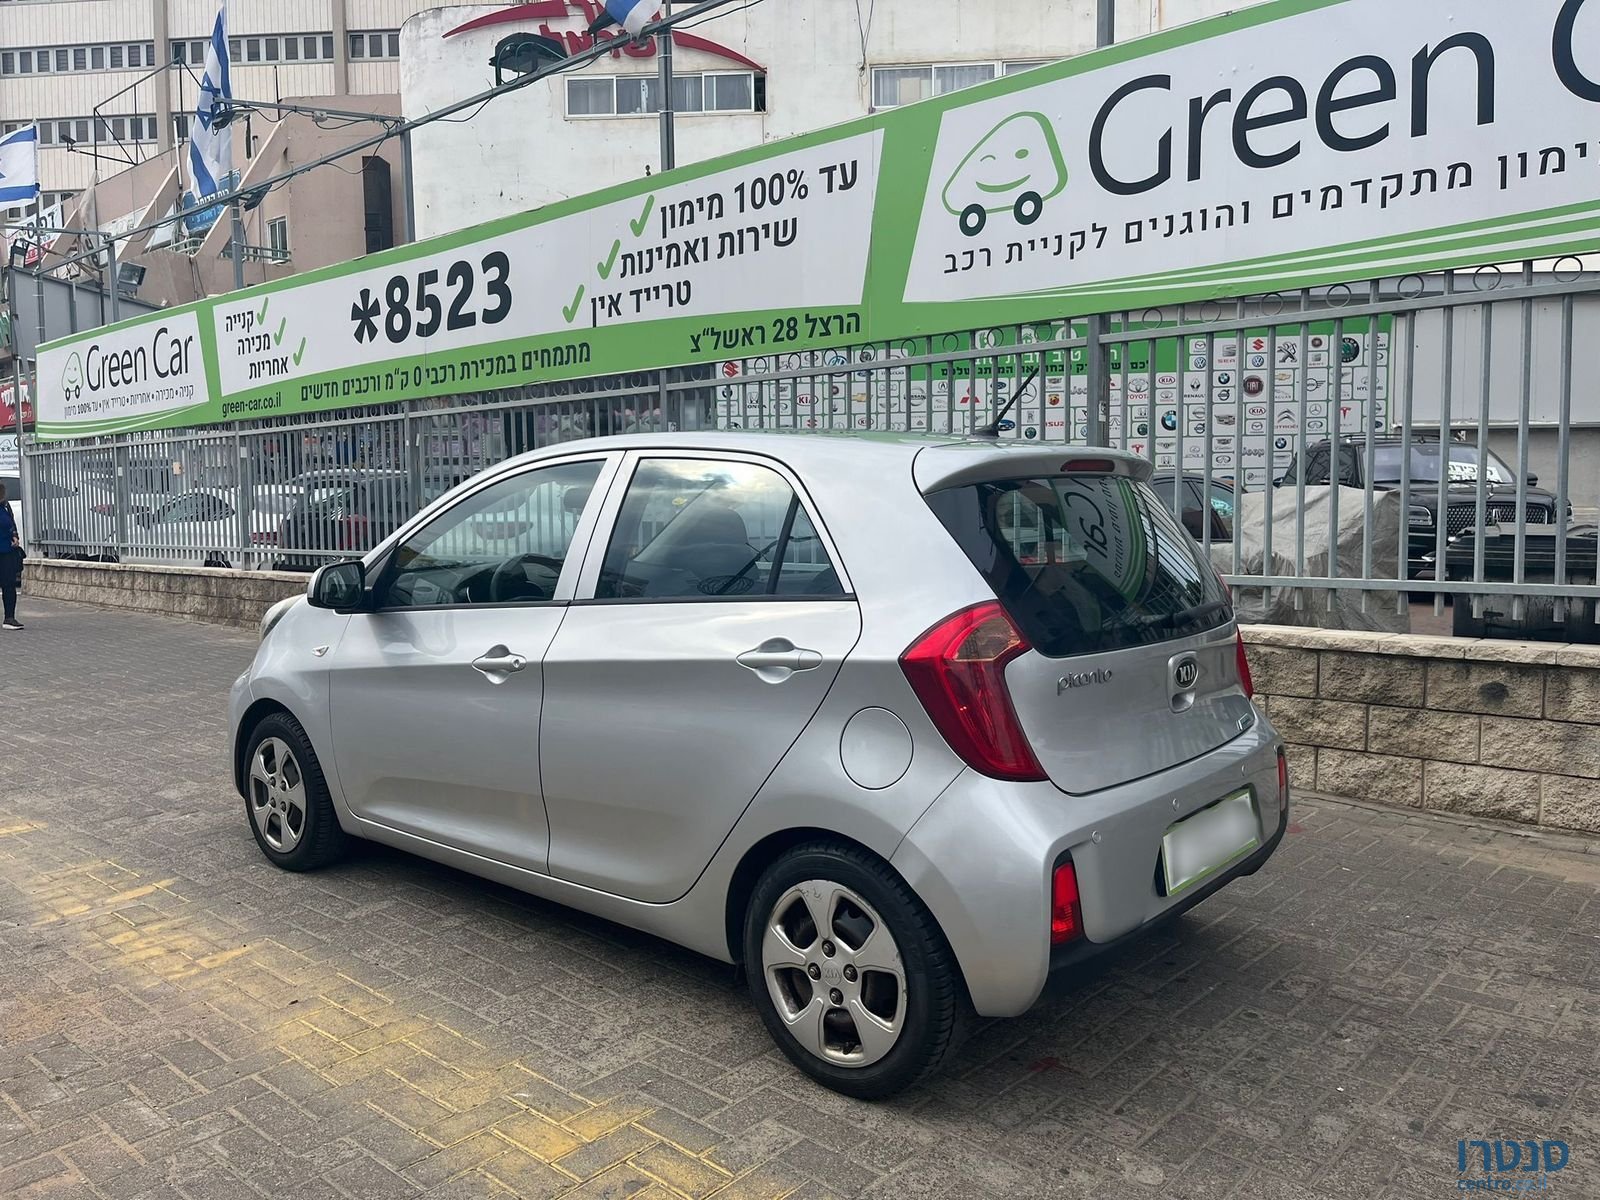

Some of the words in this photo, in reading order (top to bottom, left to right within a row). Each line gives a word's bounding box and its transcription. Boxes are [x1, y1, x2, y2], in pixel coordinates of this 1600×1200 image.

[1088, 31, 1495, 195] Green
[819, 160, 858, 193] עד
[1498, 142, 1600, 190] ימון
[734, 168, 809, 213] 100%
[1272, 161, 1472, 219] מתקדמים
[660, 192, 724, 239] מימון
[1124, 200, 1250, 244] והוגנים
[717, 217, 798, 260] שירות
[1005, 222, 1108, 264] לקניית
[620, 236, 709, 279] ואמינות
[944, 247, 992, 274] רכב
[590, 292, 622, 328] אין
[629, 279, 692, 313] טרייד
[225, 310, 254, 334] קנייה
[772, 316, 798, 343] 28
[804, 312, 860, 340] הרצל
[237, 333, 271, 356] מכירה
[521, 341, 591, 371] מתמחים
[86, 344, 147, 392] Green
[153, 327, 193, 379] Car
[248, 356, 289, 380] אחריות
[459, 353, 516, 381] במכירת
[342, 374, 381, 397] ורכבים
[413, 365, 422, 386] 0
[426, 364, 456, 387] רכבי
[1160, 376, 1174, 384] KIA
[1246, 380, 1260, 391] FIAT
[179, 384, 194, 400] קניה
[301, 379, 339, 401] חדשים
[77, 402, 91, 414] 100%
[222, 391, 282, 418] green-car.co.il
[1250, 407, 1264, 415] KIA
[1056, 668, 1113, 696] picanto
[1177, 663, 1198, 684] KIA
